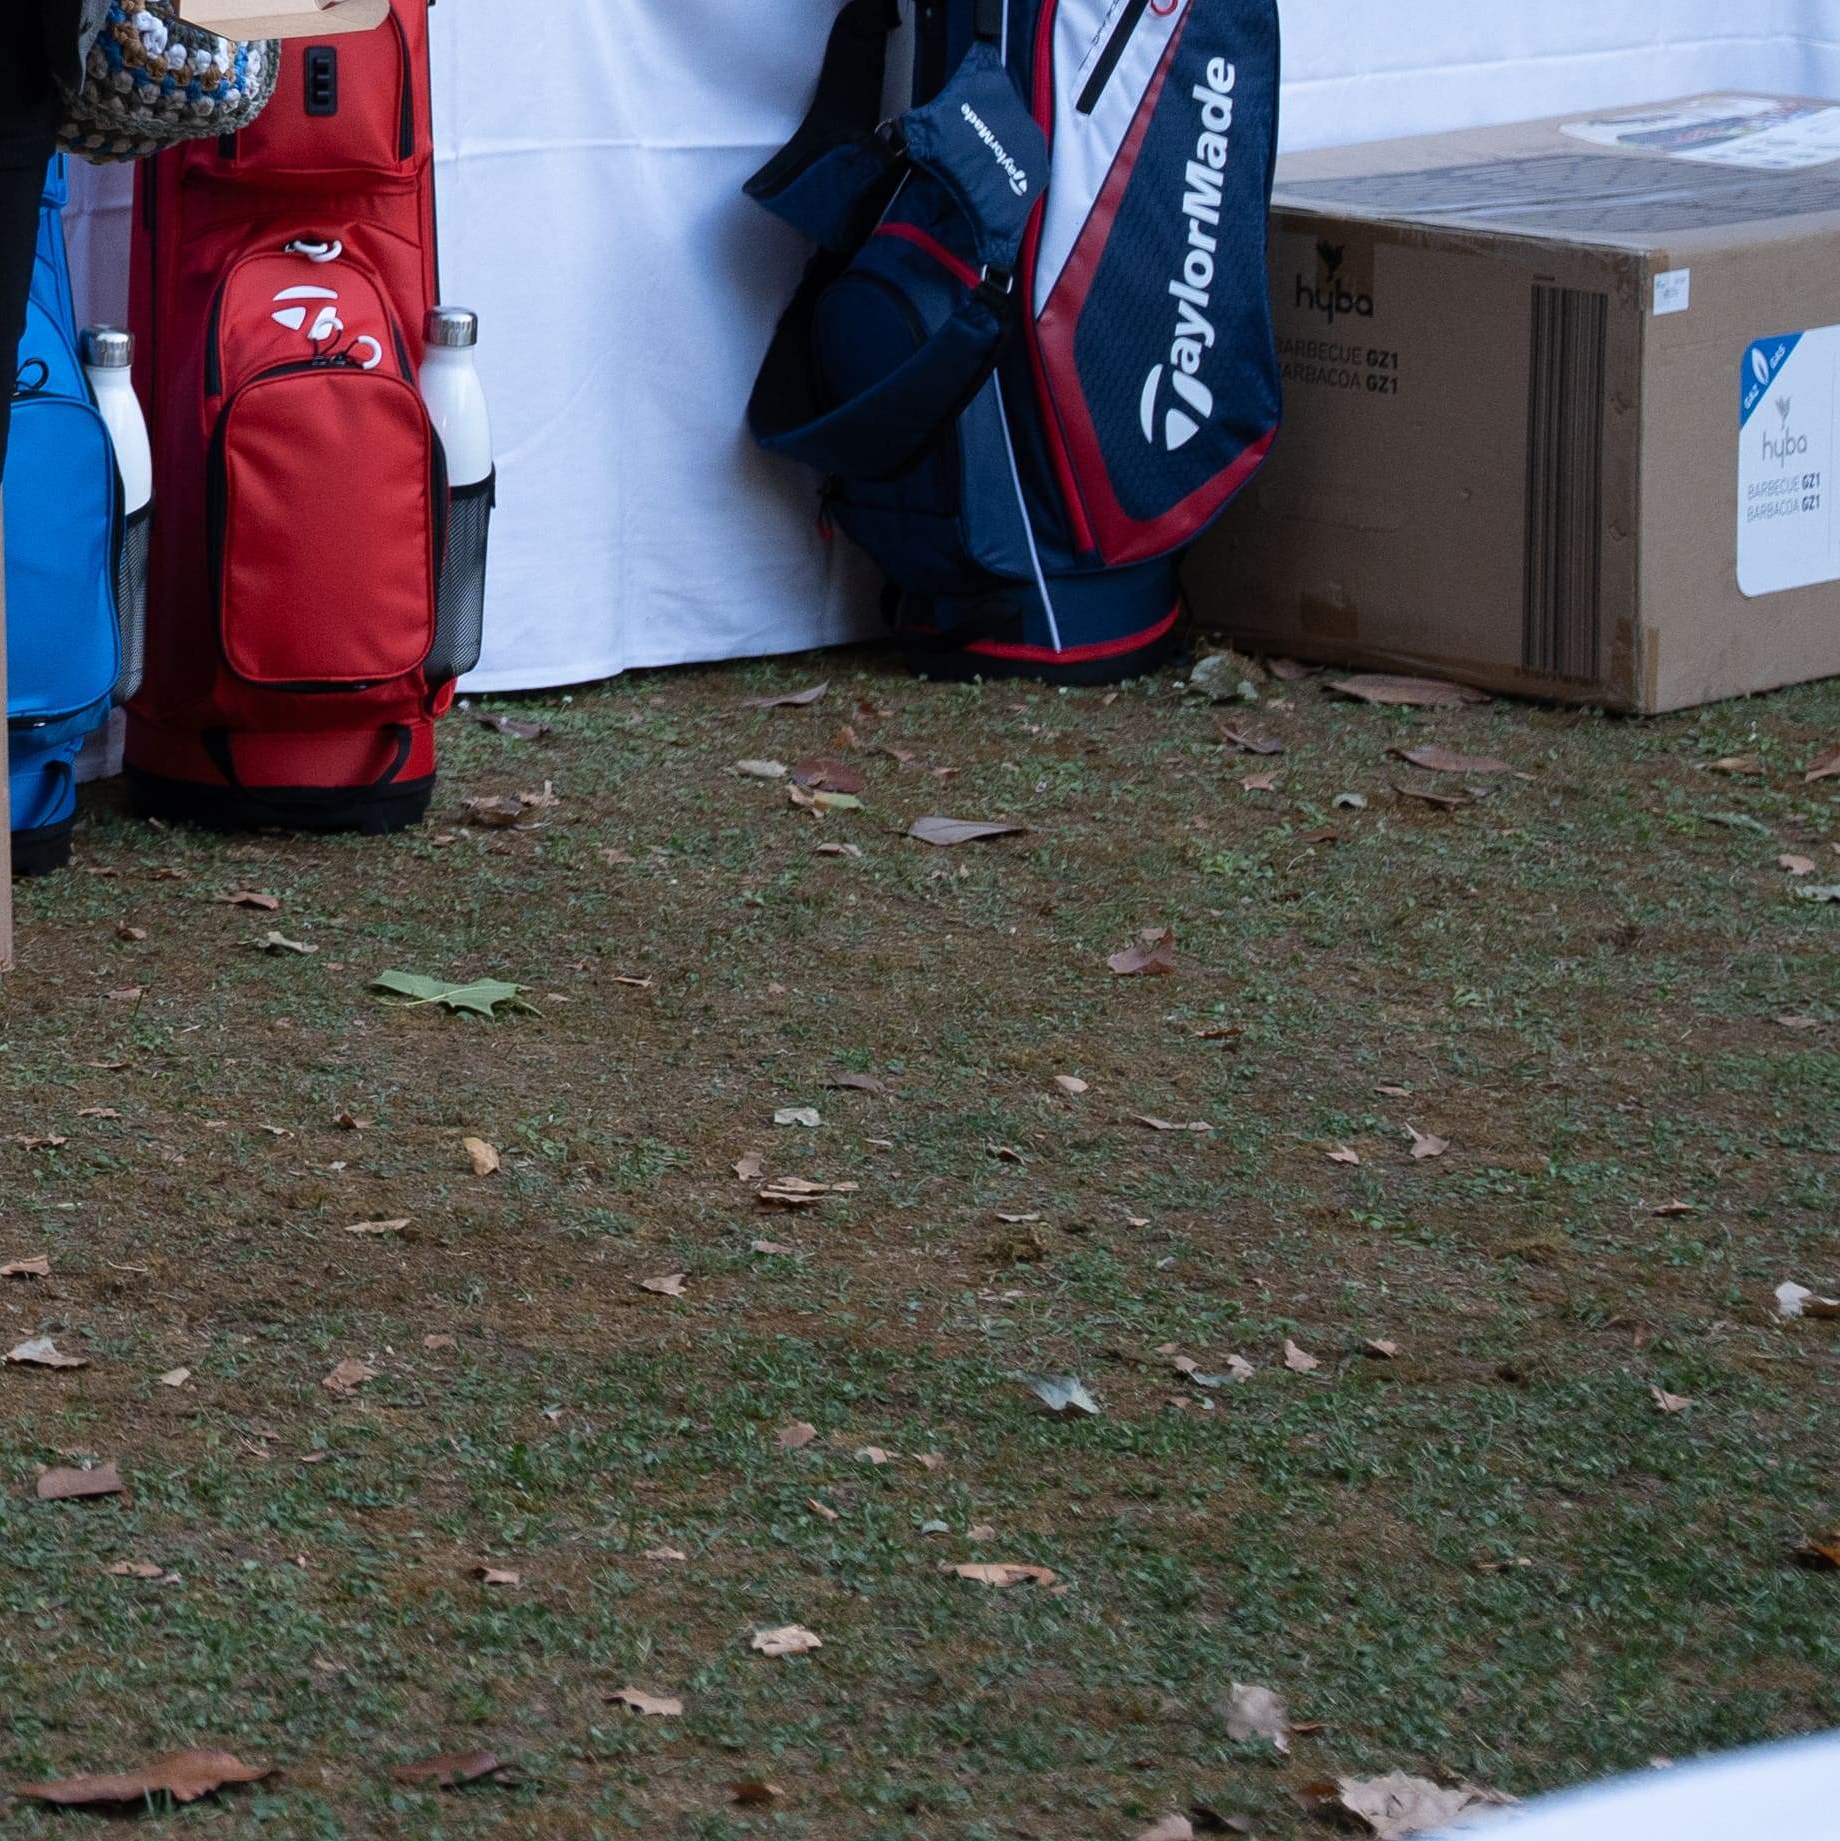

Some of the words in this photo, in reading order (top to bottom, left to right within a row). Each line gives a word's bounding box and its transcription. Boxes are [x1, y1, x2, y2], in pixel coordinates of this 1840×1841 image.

[961, 102, 1027, 196] TaylorMade
[1140, 56, 1235, 451] TaylorMade
[1295, 273, 1375, 325] hyba
[1281, 361, 1362, 389] ARBACOA
[1366, 374, 1399, 395] GZ1
[1366, 349, 1399, 370] GZ1
[1762, 426, 1808, 469] hyba
[1801, 472, 1820, 490] GZ1
[1801, 494, 1820, 512] GZ1
